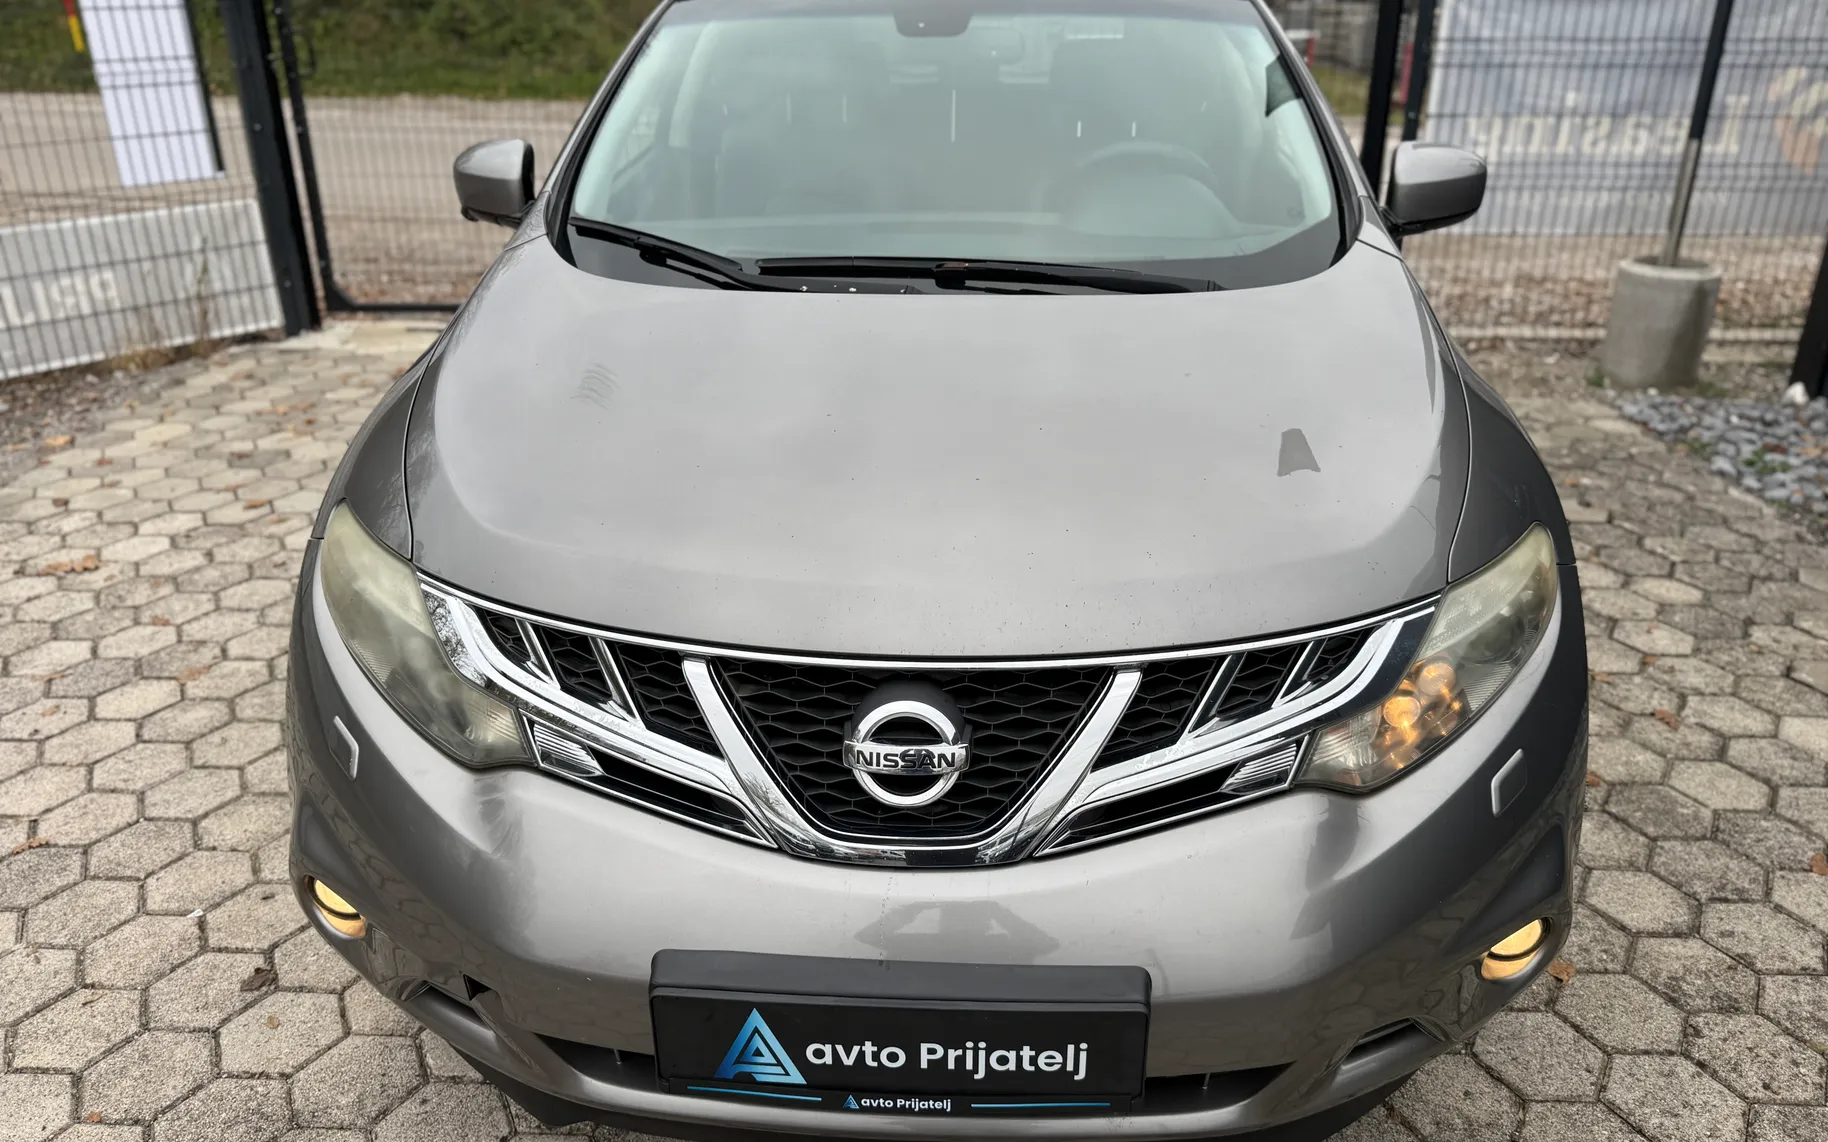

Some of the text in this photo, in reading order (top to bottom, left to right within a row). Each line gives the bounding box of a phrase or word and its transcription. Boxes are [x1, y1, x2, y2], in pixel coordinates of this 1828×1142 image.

[855, 749, 957, 769] NISSAN
[805, 1040, 1089, 1081] avto Prijatelj
[861, 1097, 952, 1112] avto Prijatelj
